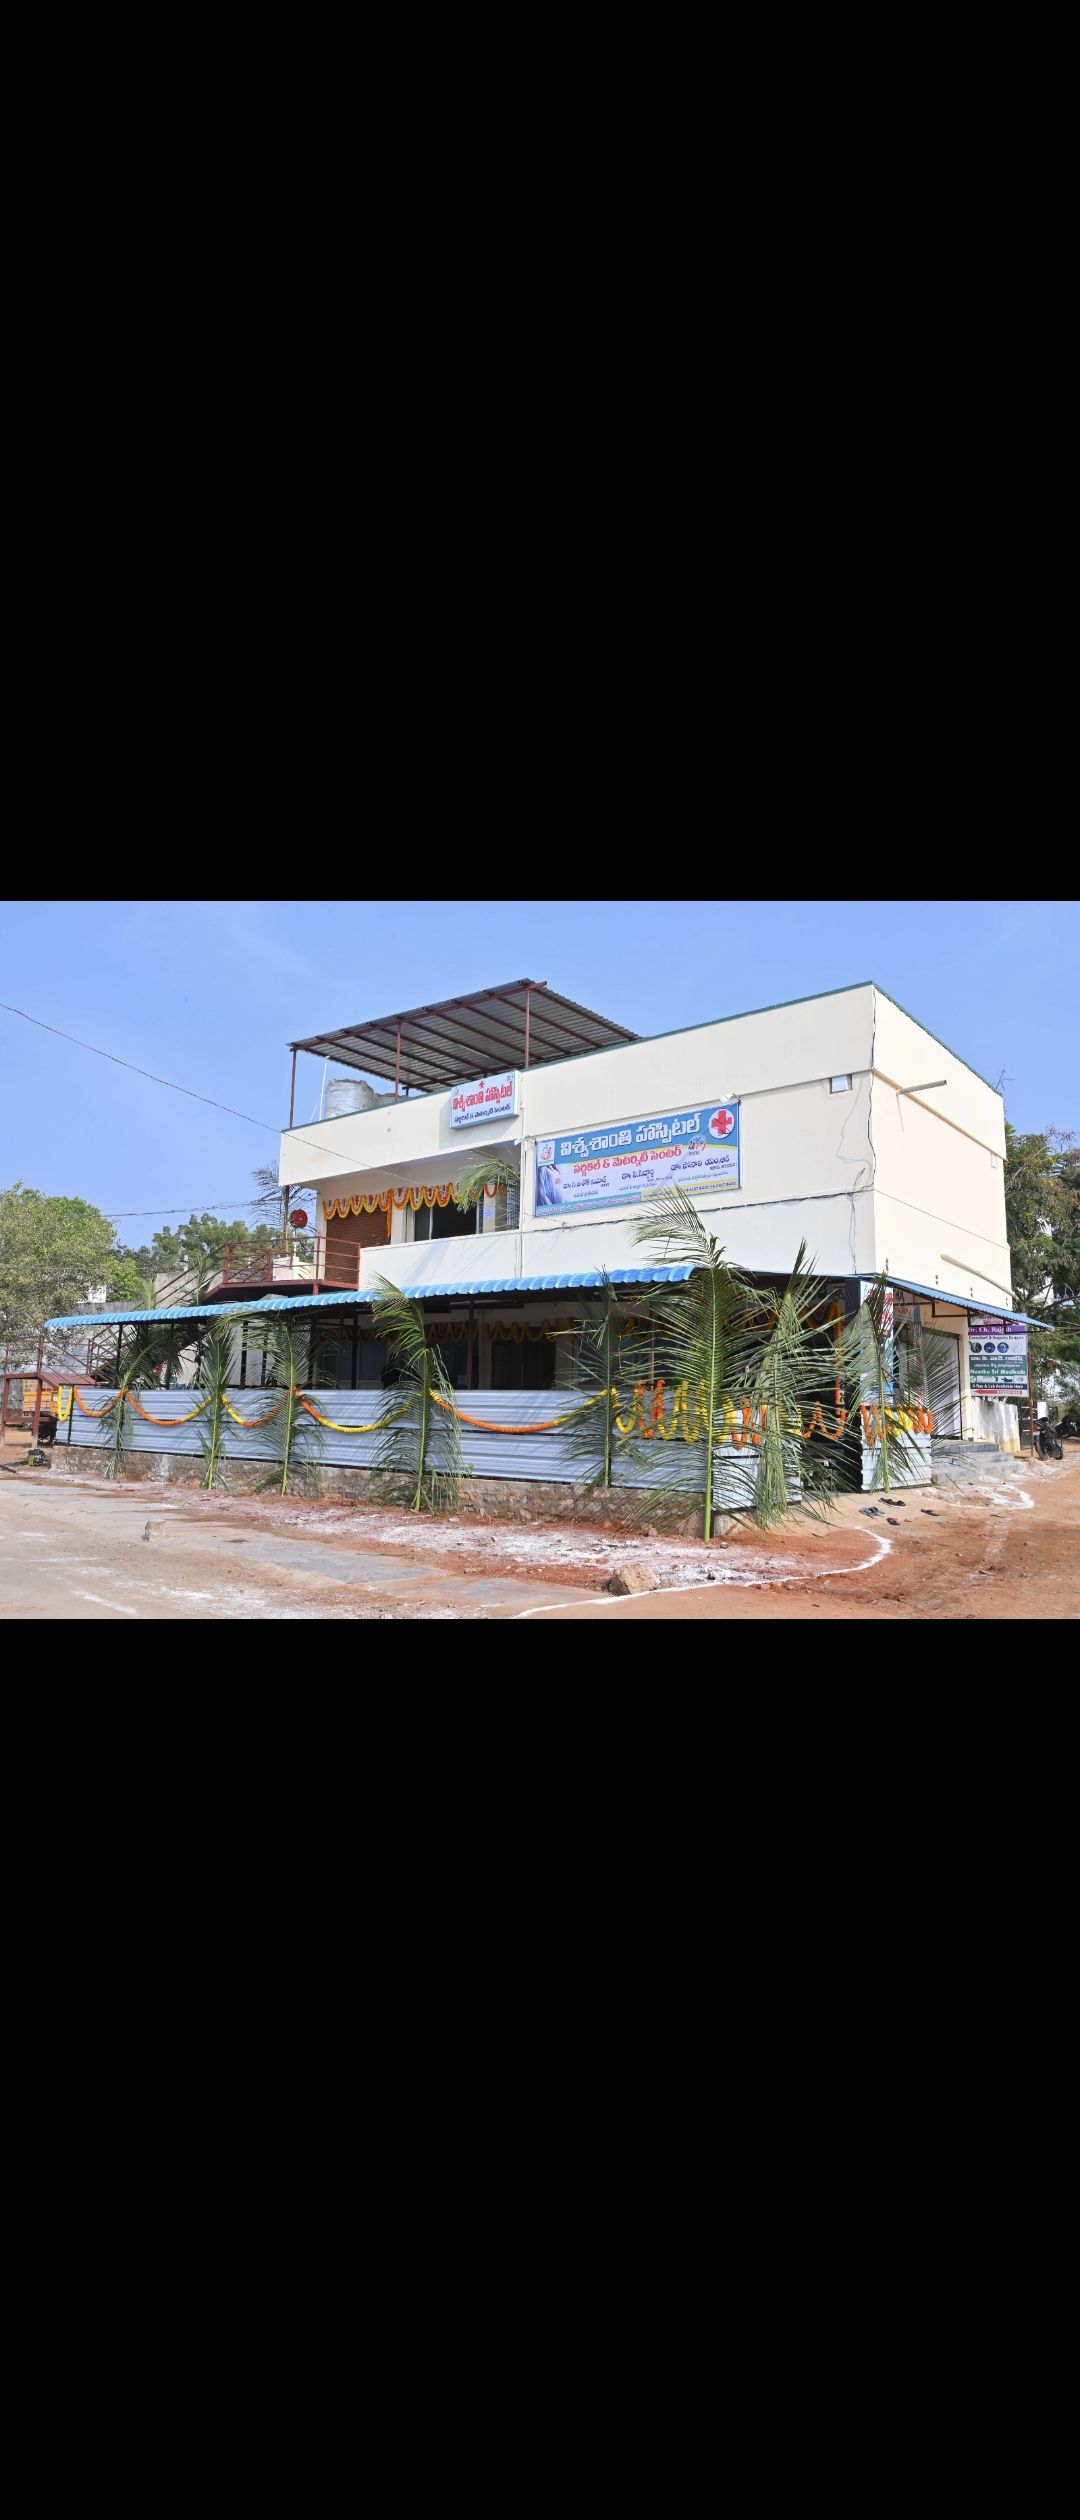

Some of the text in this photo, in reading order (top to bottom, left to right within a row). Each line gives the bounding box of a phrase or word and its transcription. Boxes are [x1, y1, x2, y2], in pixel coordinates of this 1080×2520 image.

[453, 1081, 513, 1112] విశ్వశాంతి హాస్పిటల్
[561, 1113, 701, 1157] విశ్వశాంతి హాస్పిటల్
[573, 1159, 601, 1176] సర్జికల్
[603, 1160, 610, 1169] &
[651, 1144, 682, 1160] సెంటర్
